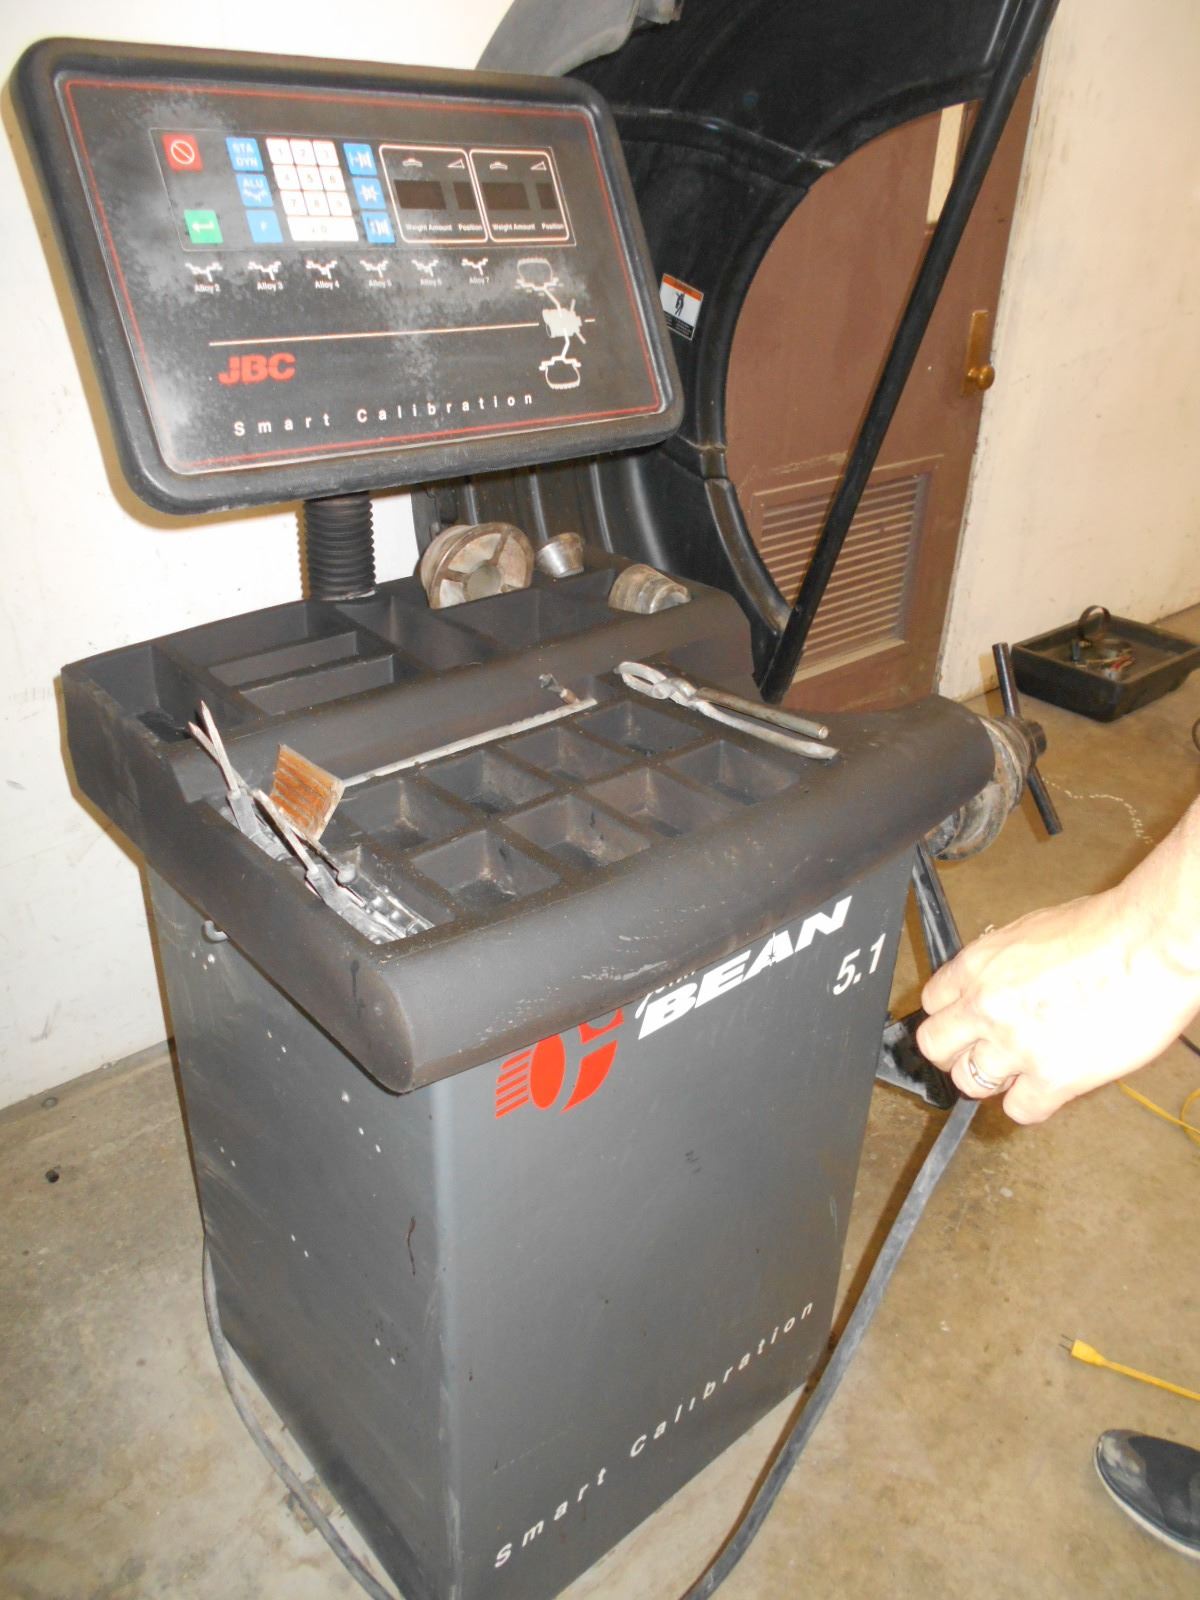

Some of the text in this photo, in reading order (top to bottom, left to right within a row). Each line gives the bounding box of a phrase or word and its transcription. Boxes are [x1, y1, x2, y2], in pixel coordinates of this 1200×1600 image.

[243, 178, 263, 189] ALU
[428, 223, 452, 231] Amount
[458, 222, 483, 231] Position
[514, 223, 536, 231] Amount
[541, 222, 564, 230] Position
[257, 281, 277, 291] Alloy
[315, 280, 333, 290] Alloy
[368, 279, 386, 288] Alloy
[420, 278, 437, 287] Alloy
[469, 277, 485, 285] Alloy
[194, 284, 214, 294] Alloy
[217, 352, 296, 386] JBC
[233, 393, 532, 436] Smart Calibration
[638, 895, 852, 1040] BEAN
[832, 933, 886, 996] 5.1
[494, 1302, 813, 1568] Smart Calibration
